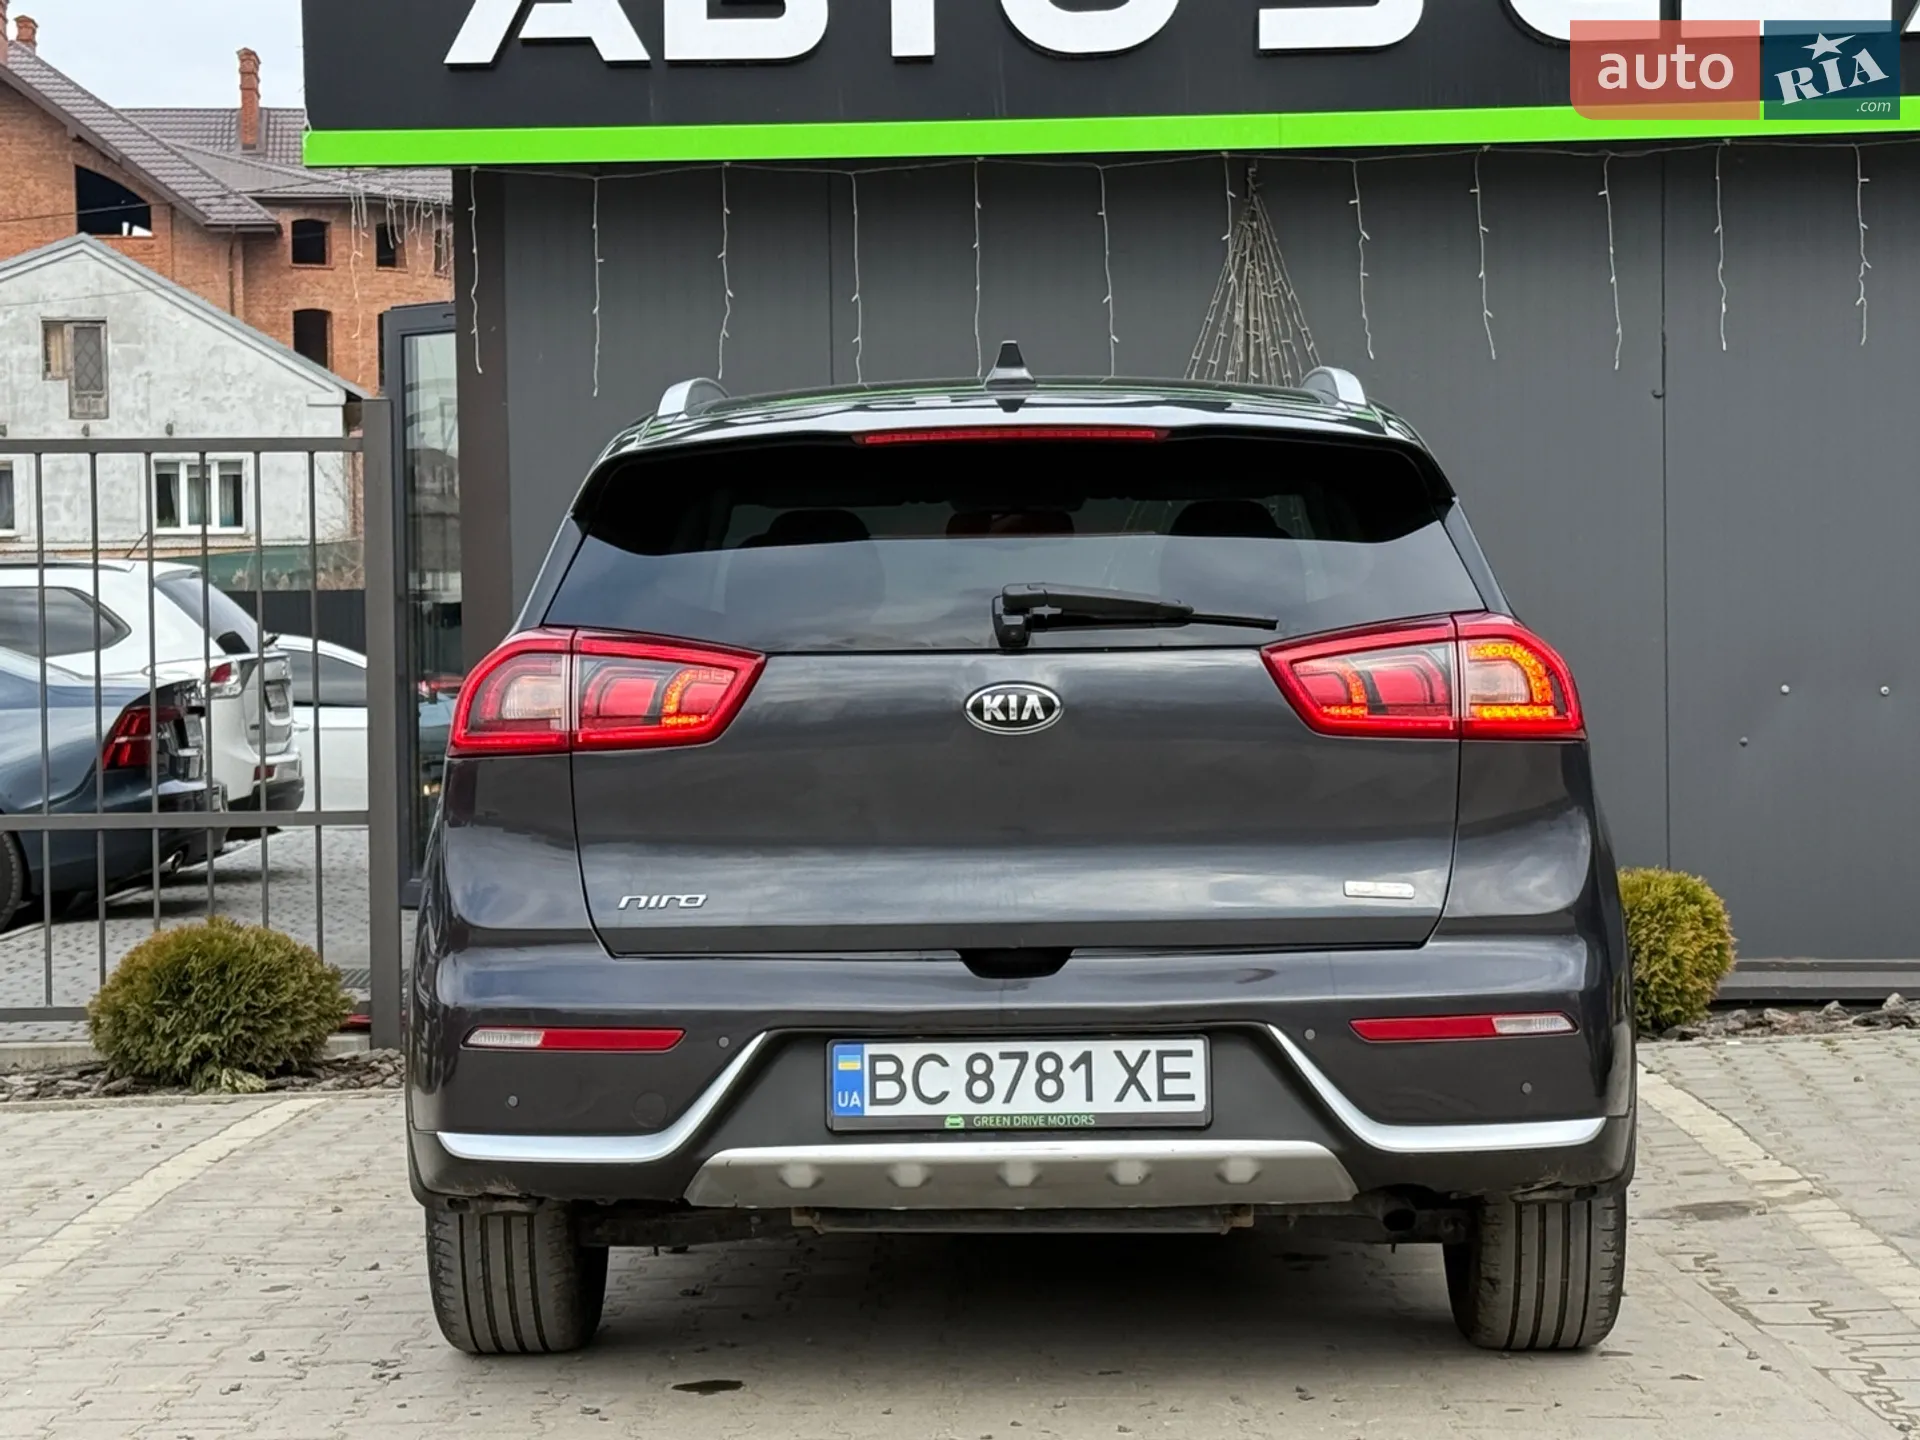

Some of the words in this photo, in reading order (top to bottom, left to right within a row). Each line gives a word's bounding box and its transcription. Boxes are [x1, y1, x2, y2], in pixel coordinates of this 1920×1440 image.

[982, 694, 1045, 721] KIA
[618, 894, 707, 910] niro
[868, 1053, 951, 1106] BC
[965, 1050, 1094, 1104] 8781
[1113, 1049, 1196, 1102] XE
[838, 1091, 861, 1107] UA
[973, 1115, 1011, 1127] GREEN
[1013, 1115, 1045, 1126] DRIVE
[1047, 1114, 1096, 1126] MOTORS
